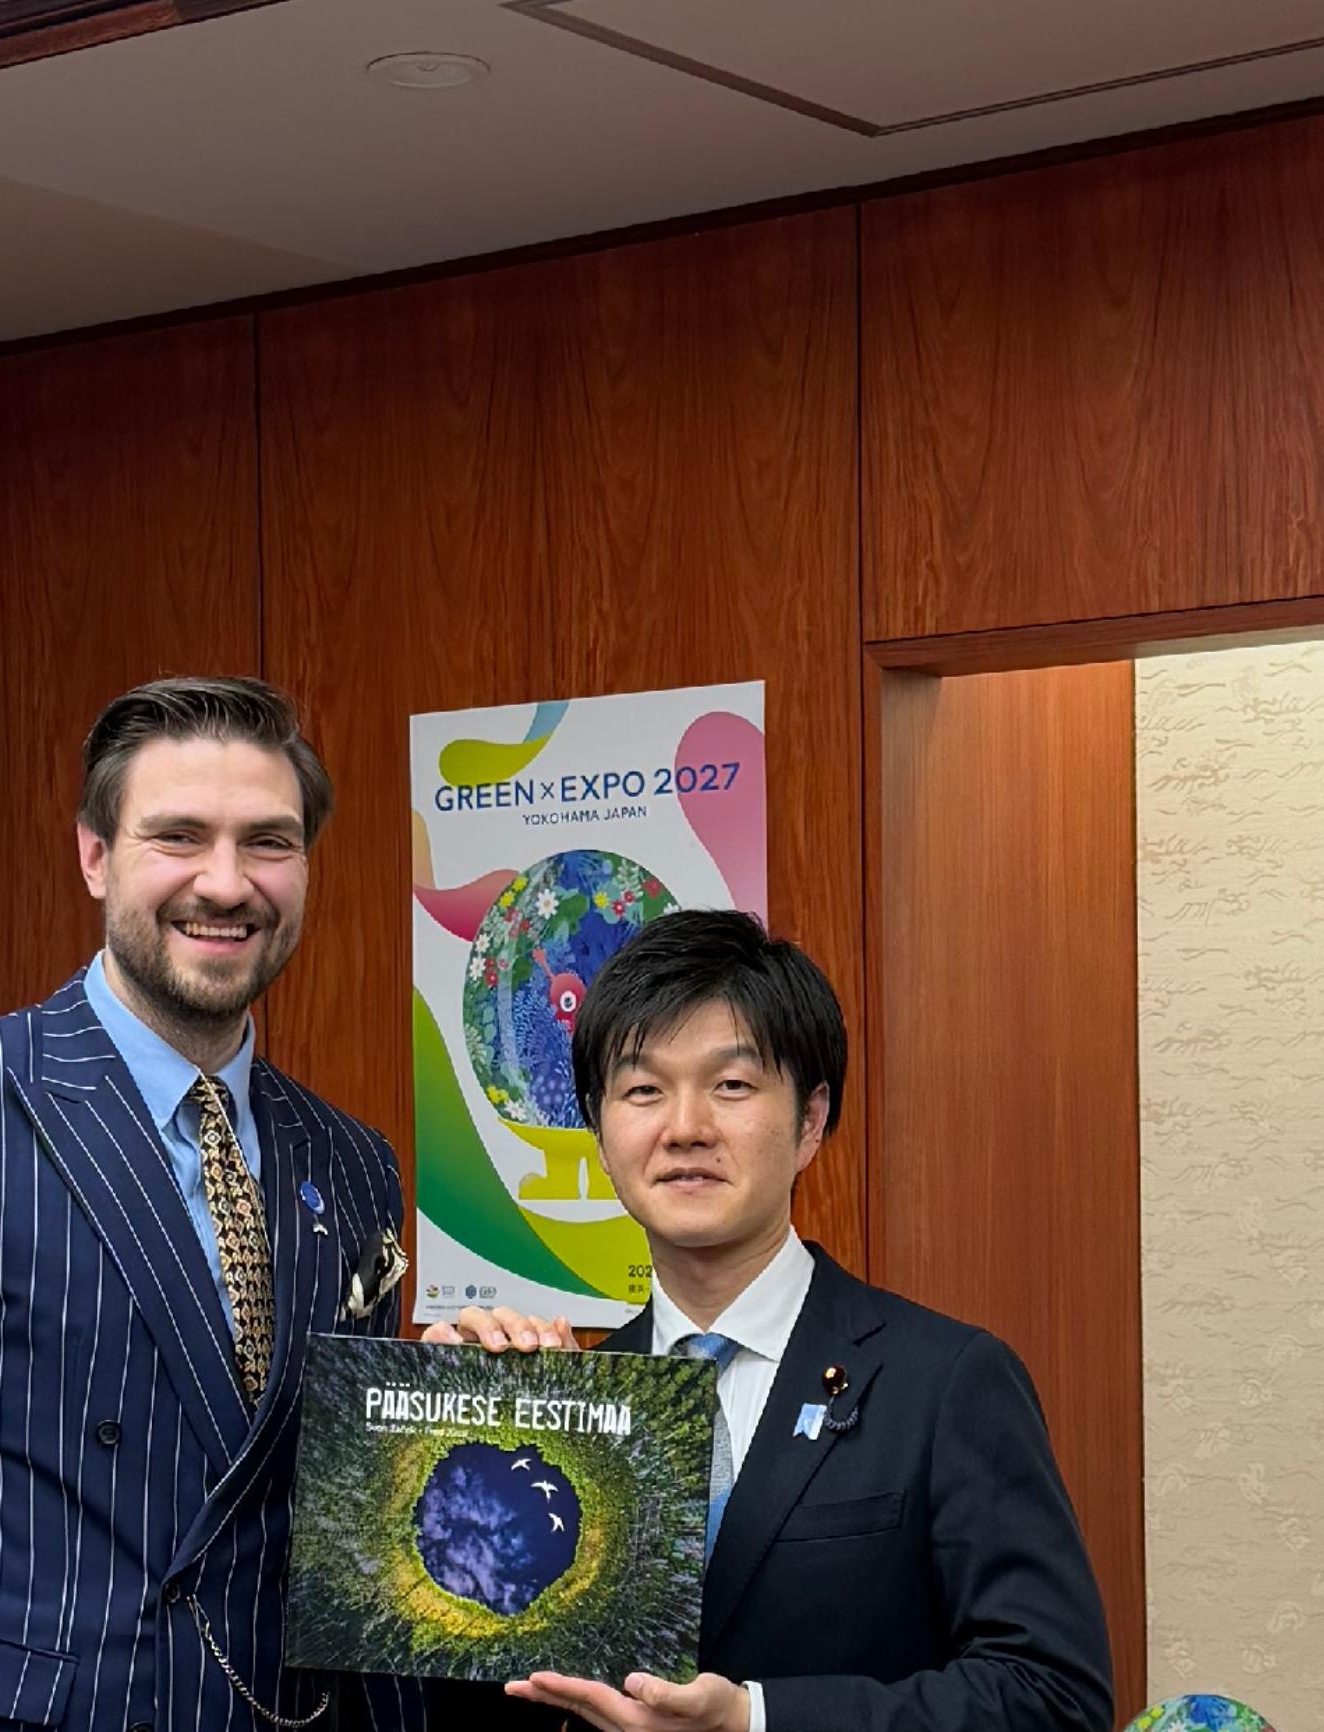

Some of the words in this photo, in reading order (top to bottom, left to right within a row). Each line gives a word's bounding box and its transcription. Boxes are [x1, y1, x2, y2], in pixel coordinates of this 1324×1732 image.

[434, 779, 534, 811] GREEN
[560, 770, 645, 802] EXPO
[653, 762, 741, 795] 2027
[522, 809, 600, 825] YOKOHAMA
[604, 805, 647, 821] JAPAN
[365, 1381, 502, 1427] PÄÄSUKESE
[515, 1397, 632, 1435] EESTIMAA
